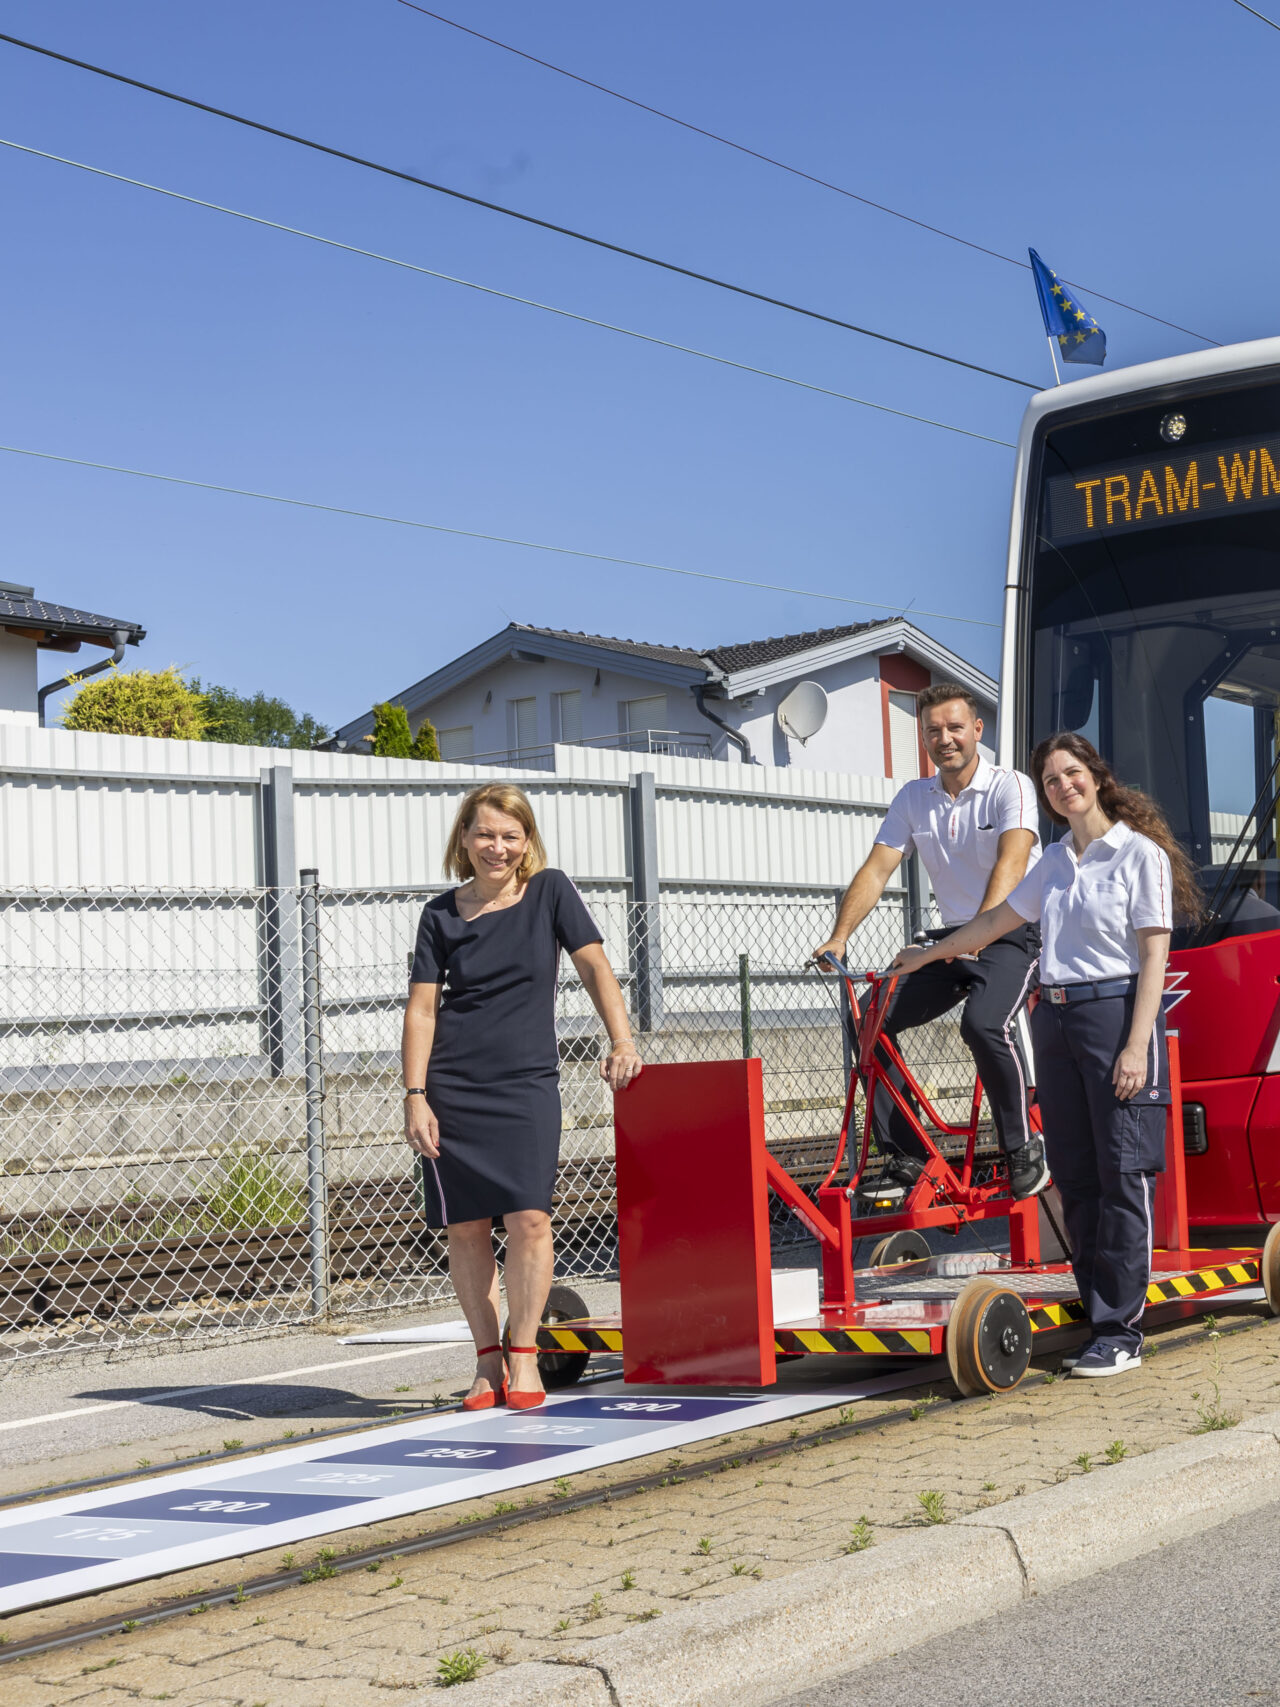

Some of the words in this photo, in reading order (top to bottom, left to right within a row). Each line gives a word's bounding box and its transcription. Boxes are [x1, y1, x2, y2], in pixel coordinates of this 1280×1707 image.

[601, 1402, 682, 1413] 300
[504, 1424, 596, 1435] 275
[404, 1448, 497, 1459] 250
[295, 1472, 395, 1485] 225
[168, 1500, 272, 1513] 200
[53, 1527, 153, 1542] 175
